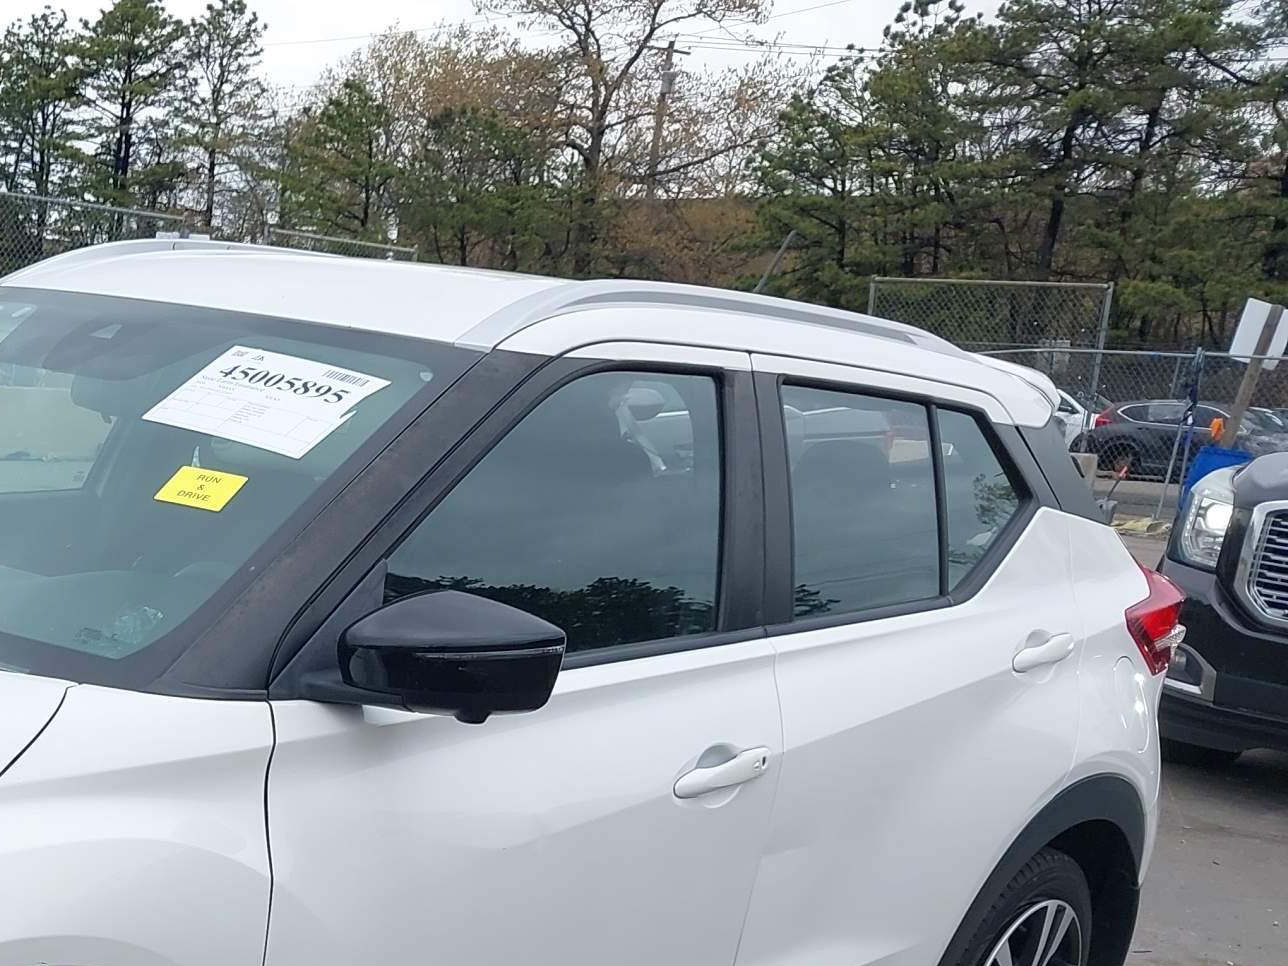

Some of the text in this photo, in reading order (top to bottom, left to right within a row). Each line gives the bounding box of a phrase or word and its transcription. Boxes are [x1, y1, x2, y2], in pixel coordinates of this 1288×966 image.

[219, 365, 351, 403] 45005895
[196, 474, 222, 484] RUN
[176, 490, 211, 501] DRIVE
